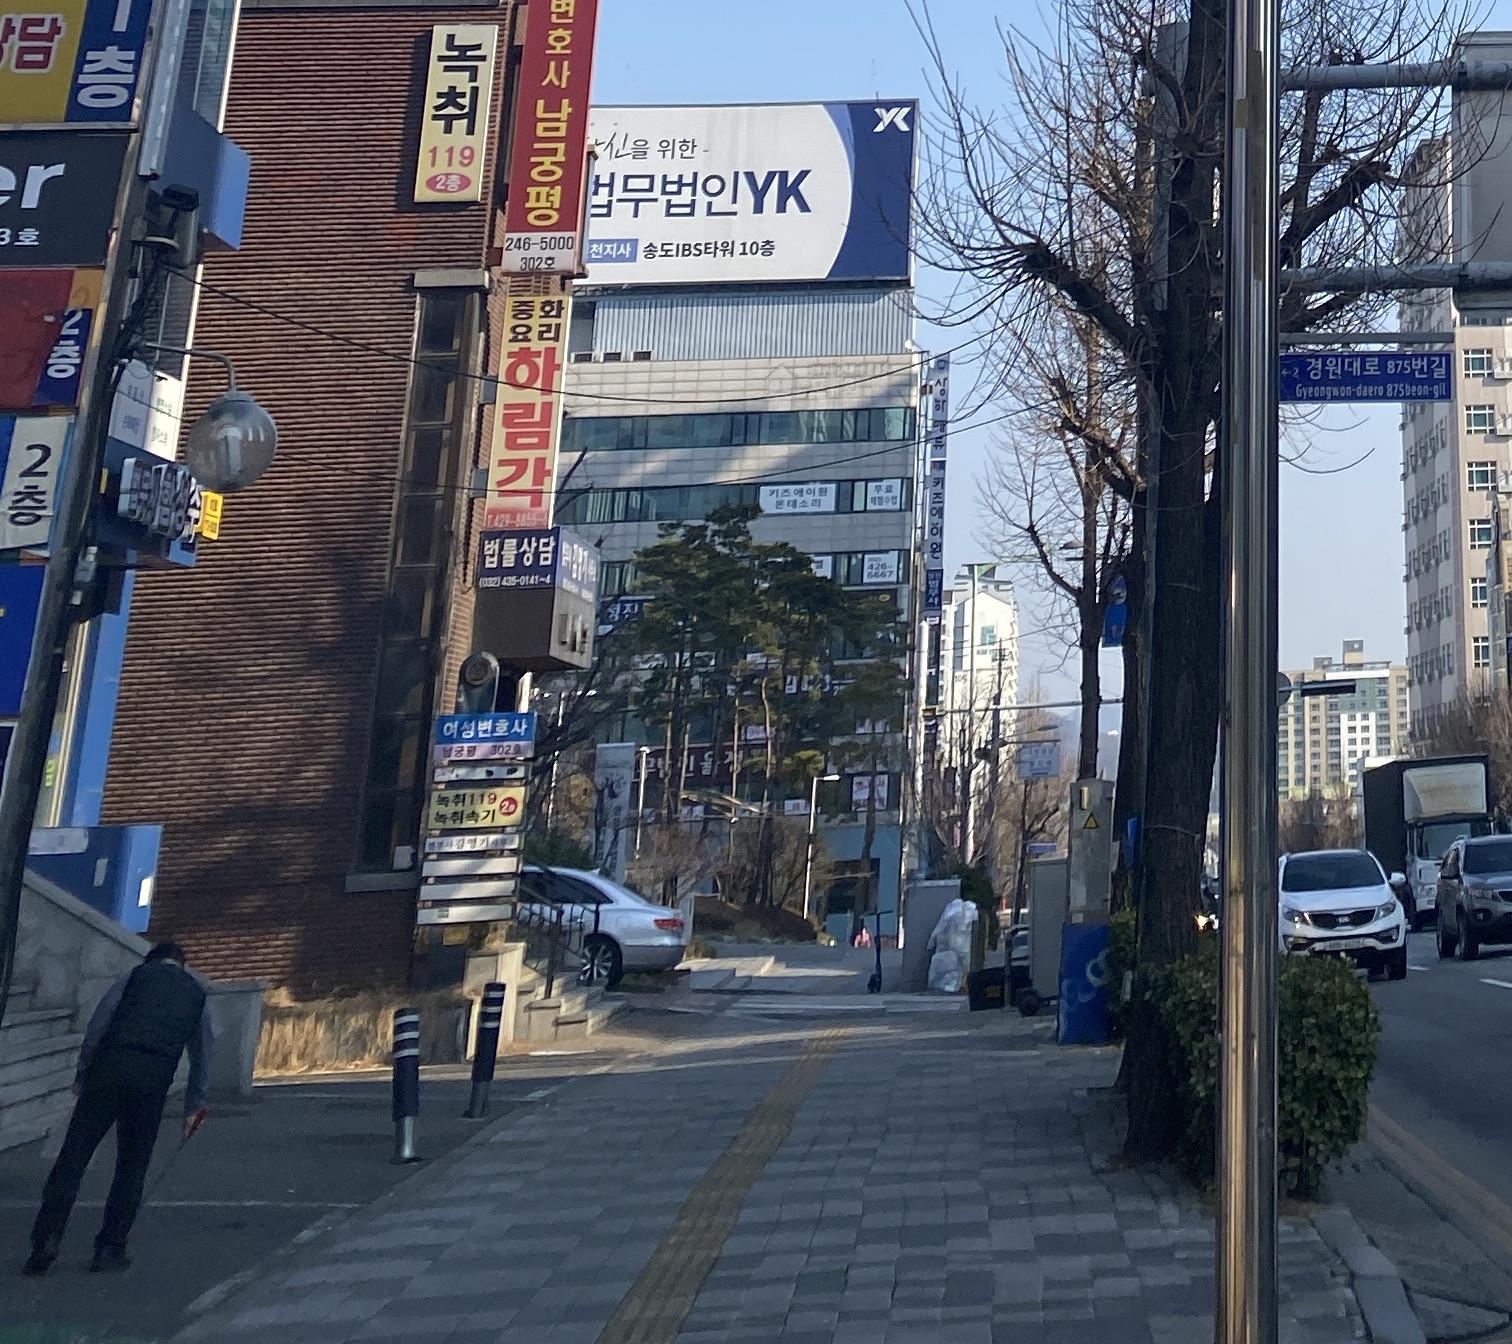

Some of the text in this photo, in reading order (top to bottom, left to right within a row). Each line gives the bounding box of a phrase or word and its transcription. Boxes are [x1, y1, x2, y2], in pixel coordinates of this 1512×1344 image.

[431, 32, 488, 137] 녹취
[428, 144, 476, 169] 119
[657, 138, 698, 160] 위한
[524, 98, 572, 228] 남궁평
[434, 174, 466, 194] 2층
[505, 235, 575, 252] 246-5000
[642, 239, 776, 260] 송도IBS타워 10층
[519, 257, 556, 272] 302호
[511, 299, 565, 321] 중화
[508, 322, 561, 343] 요리
[1306, 357, 1447, 380] 경원대로 875번길
[1295, 383, 1446, 399] Gyeongwon-daero 875beon-gil
[495, 346, 561, 508] 하림각
[7, 442, 54, 528] 2층
[768, 486, 828, 498] 키즈에이원
[442, 718, 528, 739] 여성변호사
[435, 792, 497, 809] 녹취119
